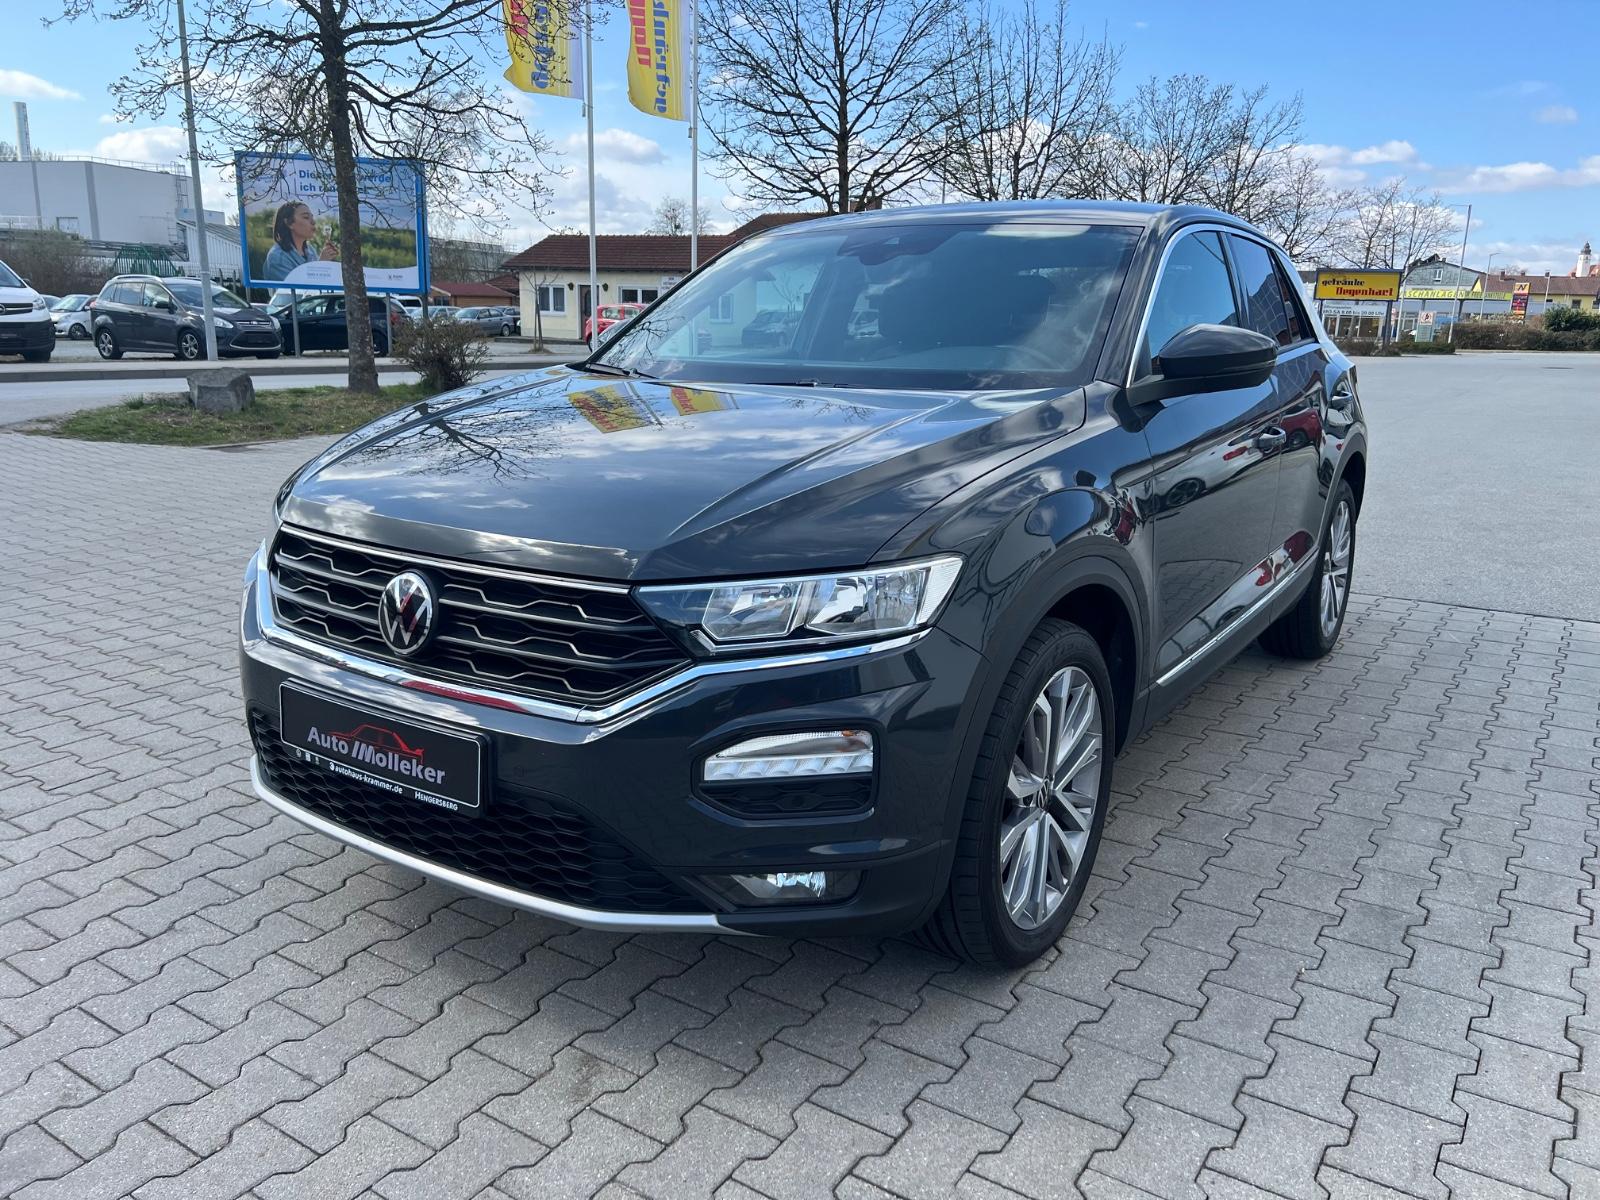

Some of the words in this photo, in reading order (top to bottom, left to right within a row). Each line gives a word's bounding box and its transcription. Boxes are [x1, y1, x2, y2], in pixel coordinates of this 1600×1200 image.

[300, 182, 316, 192] ich
[307, 726, 349, 755] Auto
[334, 764, 403, 795] autohaus-krammer.de
